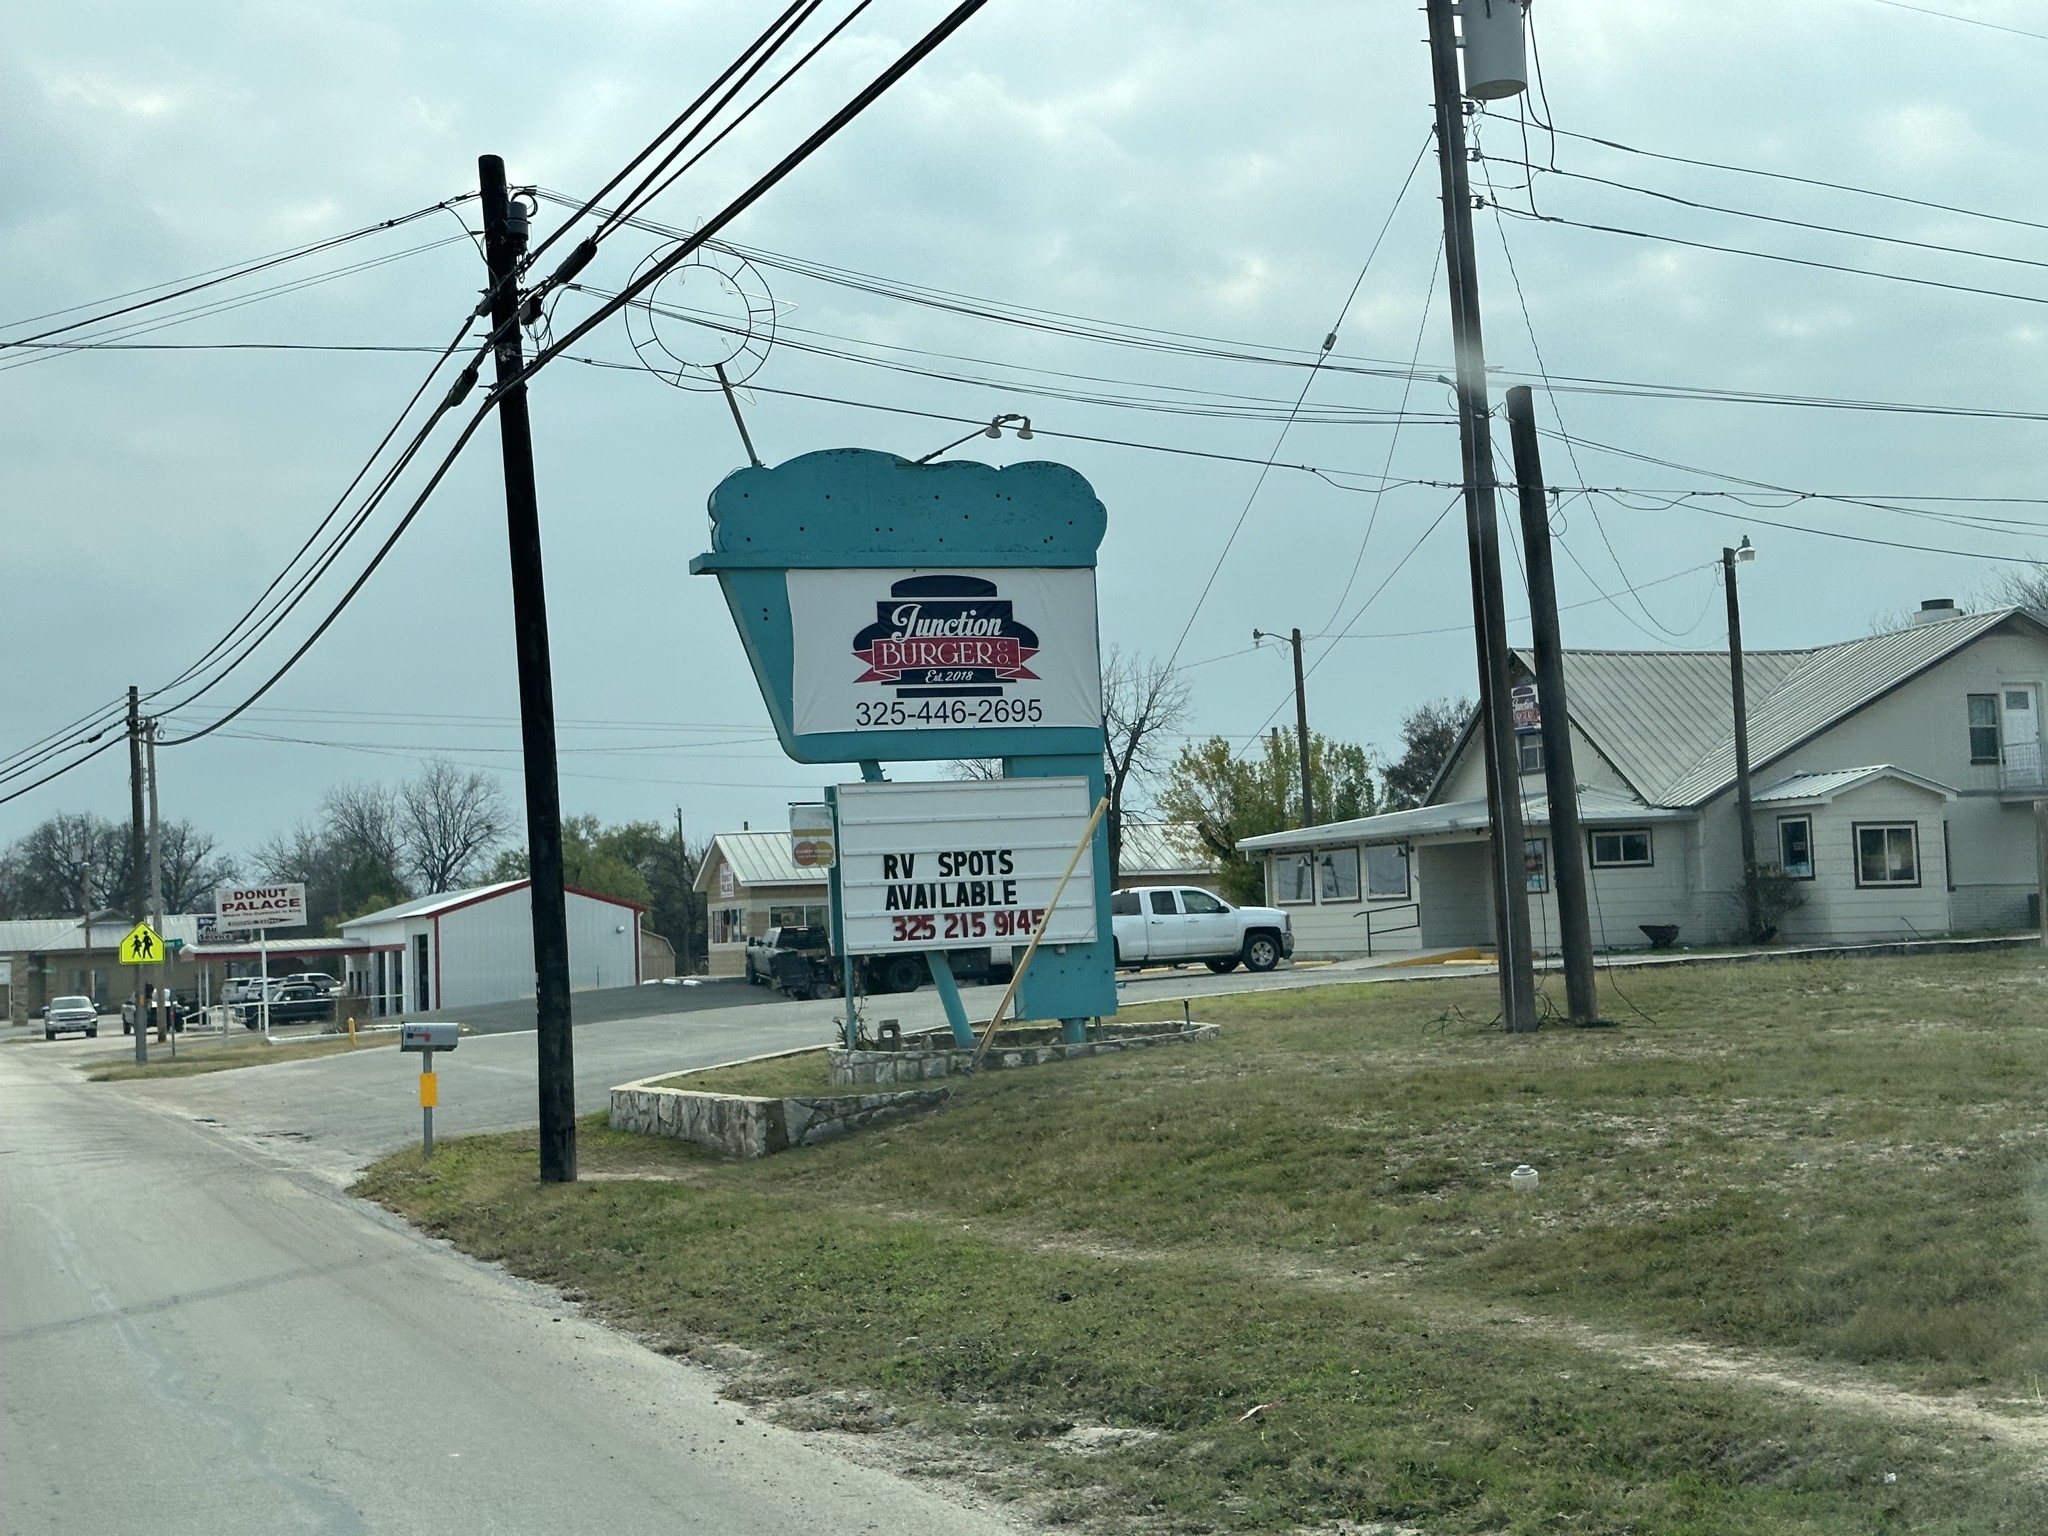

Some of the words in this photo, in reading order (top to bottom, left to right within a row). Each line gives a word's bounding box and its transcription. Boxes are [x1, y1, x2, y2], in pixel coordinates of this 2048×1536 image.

[891, 603, 1003, 643] Junction
[882, 642, 993, 666] BURGER
[925, 670, 944, 683] Est.
[945, 671, 974, 681] 2018
[855, 698, 1043, 727] 325-446-2695
[883, 853, 916, 880] RV
[937, 850, 1014, 877] SPOTS
[221, 898, 301, 912] PALACE
[233, 888, 288, 900] DONUT
[885, 880, 1018, 911] AVAILABLE
[892, 914, 937, 941] 325
[944, 912, 987, 939] 215
[993, 909, 1046, 937] 9145
